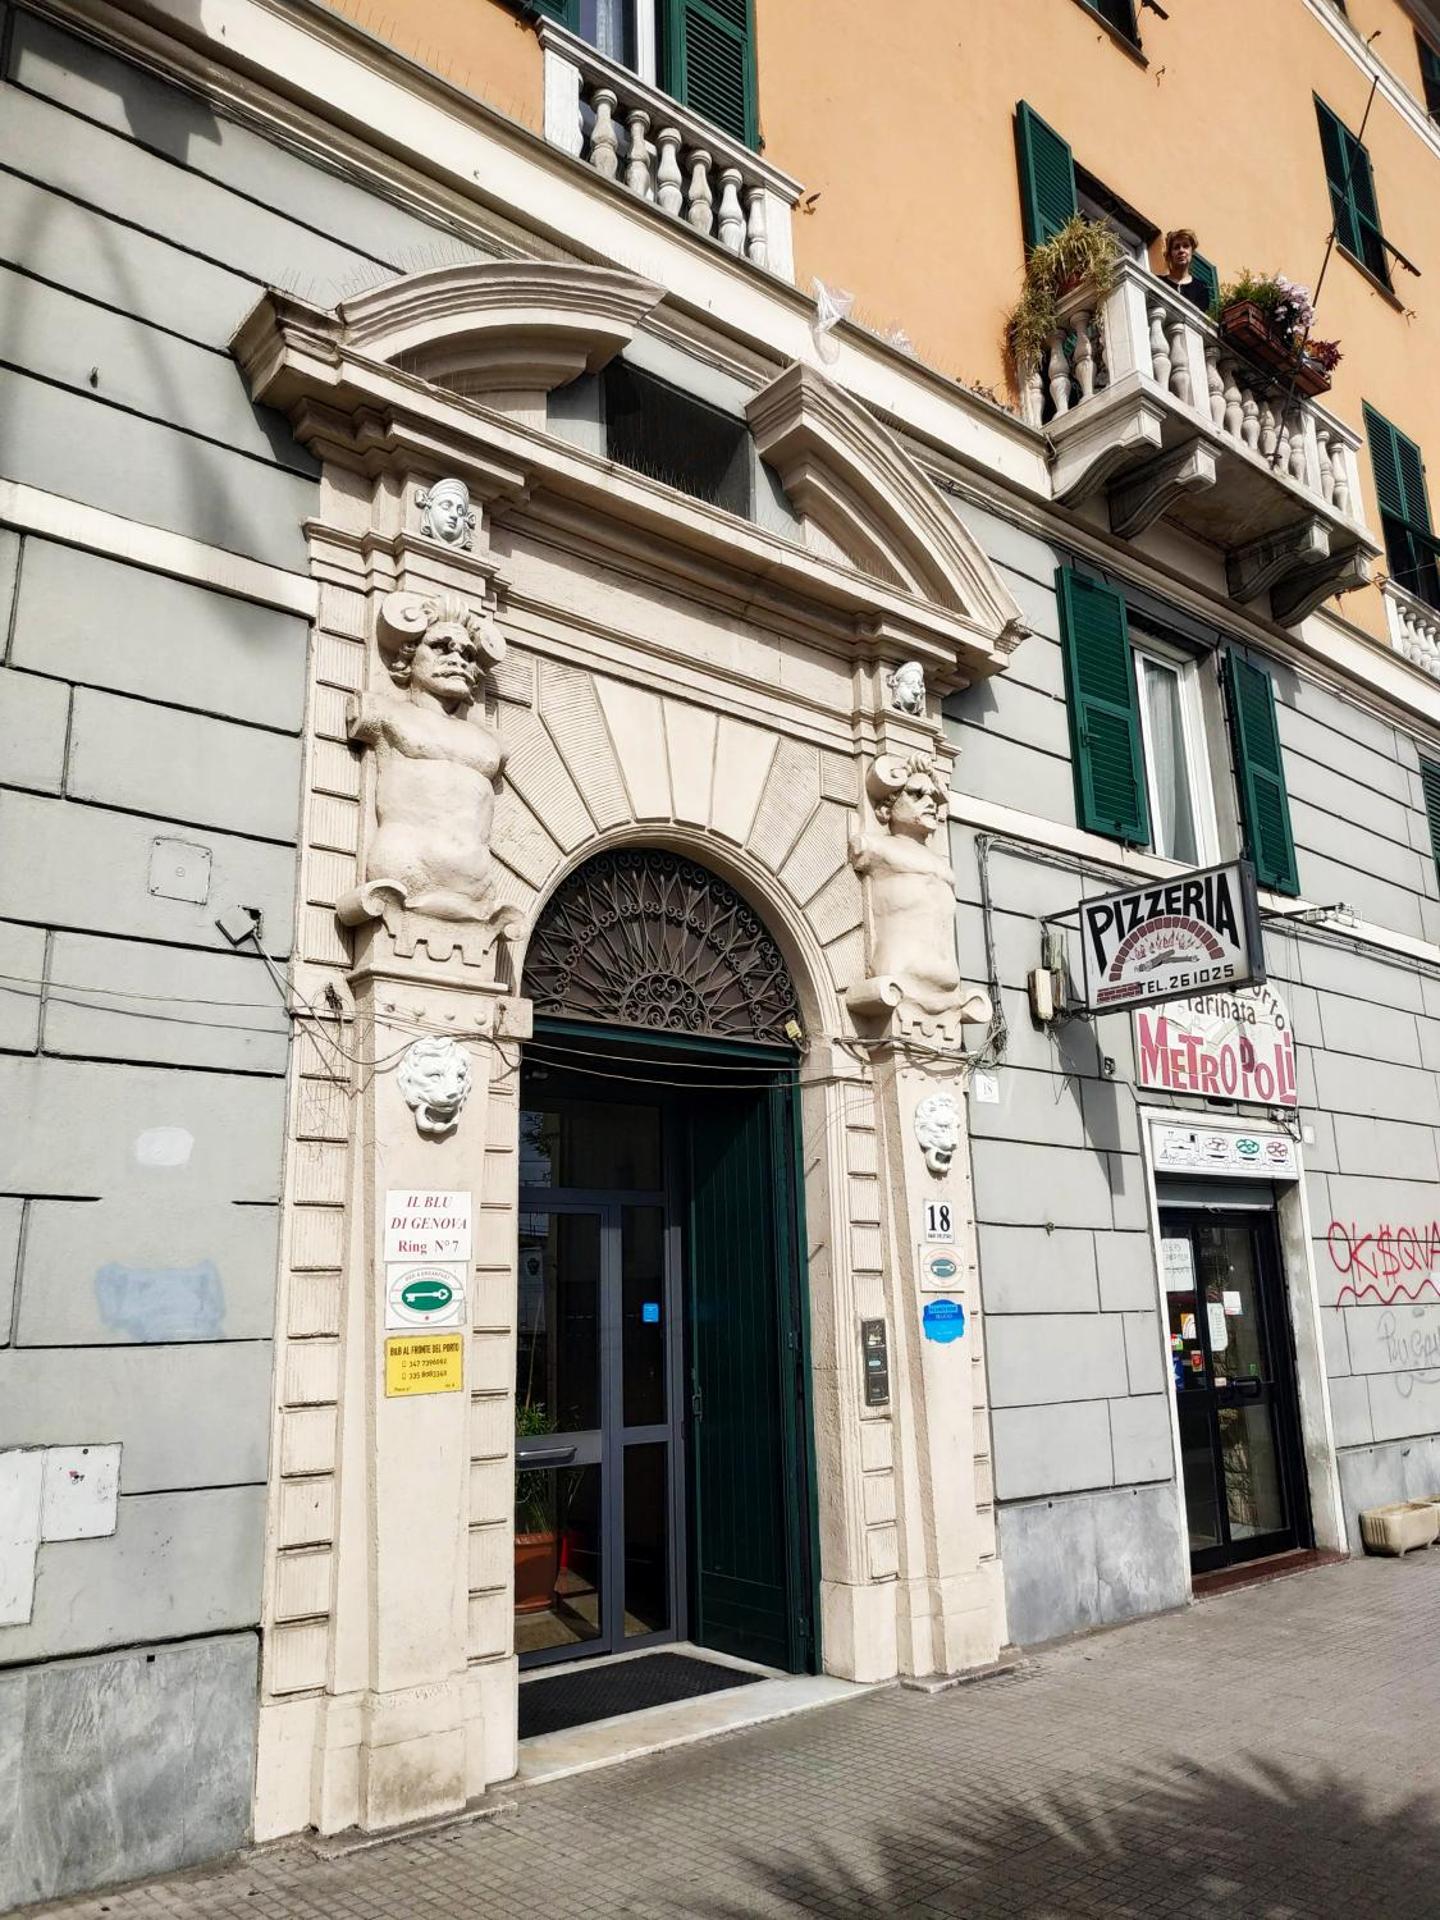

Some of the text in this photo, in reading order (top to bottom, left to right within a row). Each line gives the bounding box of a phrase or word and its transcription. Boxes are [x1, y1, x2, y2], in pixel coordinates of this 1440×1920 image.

[1086, 872, 1241, 978] PIZZERIA
[407, 1195, 454, 1208] IL BLU
[390, 1217, 467, 1230] DI GENOVA
[927, 1204, 951, 1232] 18
[398, 1239, 428, 1256] Ring
